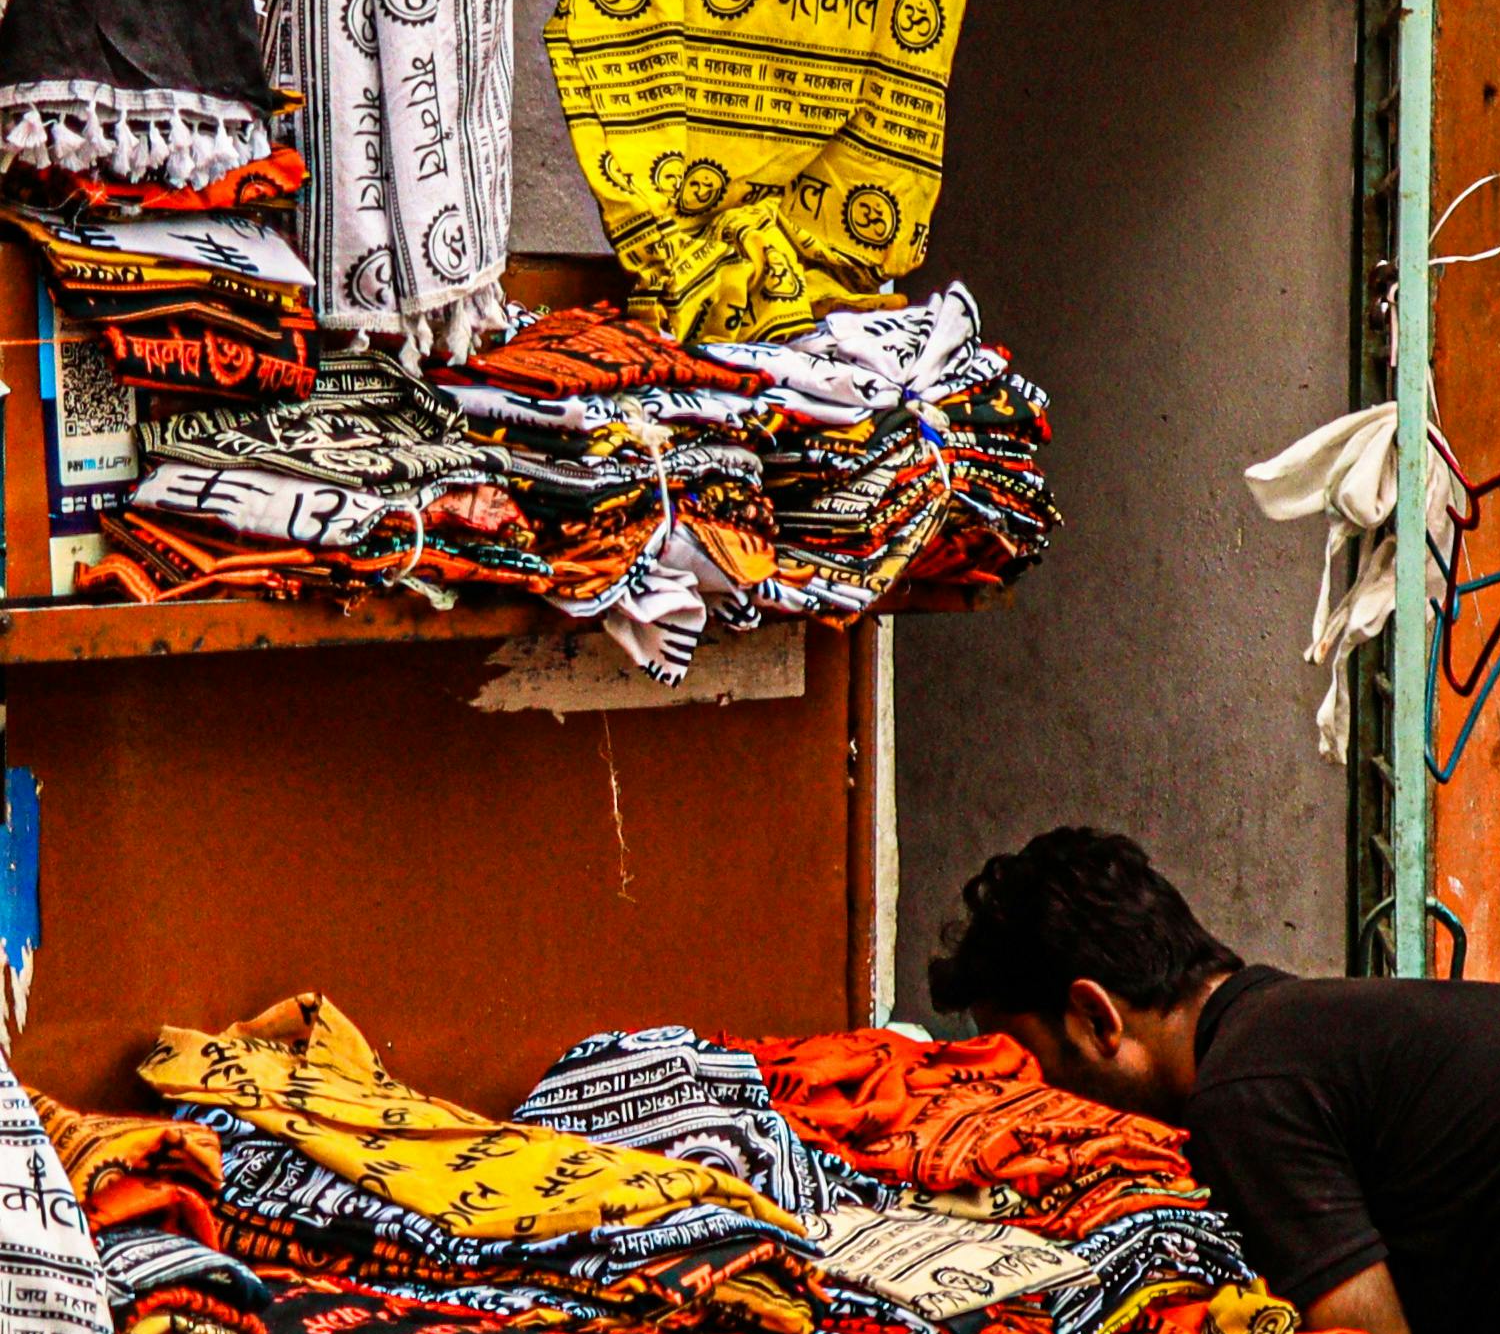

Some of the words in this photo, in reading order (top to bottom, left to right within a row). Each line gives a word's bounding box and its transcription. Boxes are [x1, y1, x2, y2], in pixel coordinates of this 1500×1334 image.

[773, 69, 797, 85] जय
[803, 71, 853, 95] महाकाल
[403, 53, 453, 181] महाकाल
[771, 99, 792, 114] जय
[16, 1288, 47, 1305] जय
